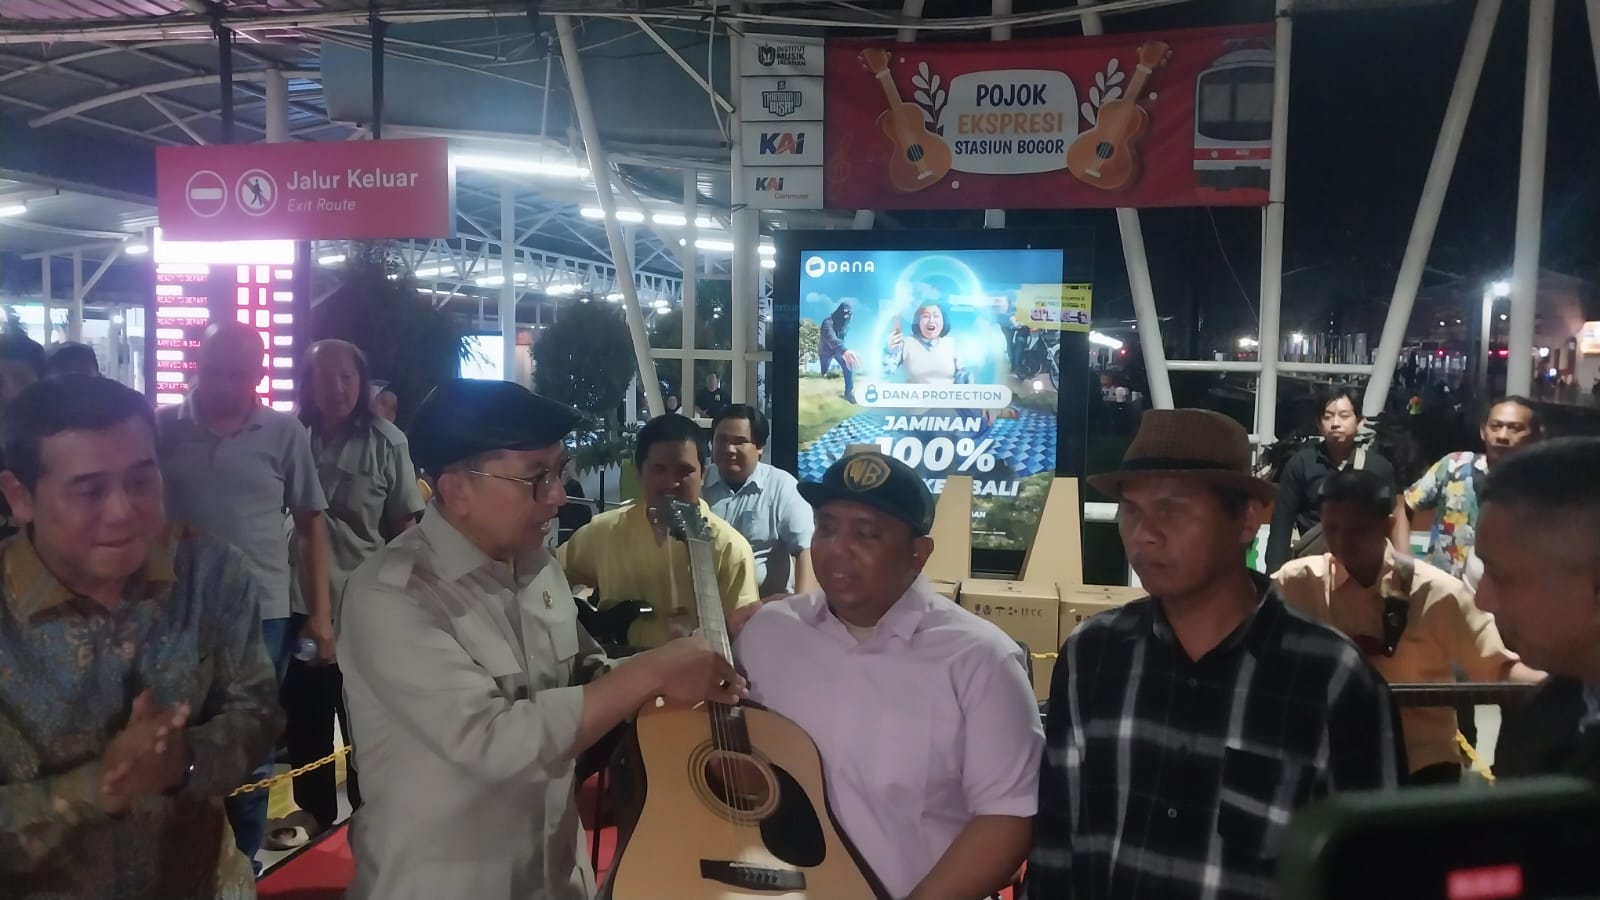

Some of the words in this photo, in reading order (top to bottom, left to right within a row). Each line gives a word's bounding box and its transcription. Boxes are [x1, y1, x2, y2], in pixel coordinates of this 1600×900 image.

[976, 83, 1047, 107] POJOK
[957, 112, 1063, 135] EKSPRESI
[955, 140, 1012, 155] STASIUN
[1017, 139, 1065, 154] BOGOR
[286, 169, 341, 190] Jalur
[347, 168, 419, 188] Keluar
[287, 198, 312, 212] Exit
[317, 198, 356, 211] Route
[828, 260, 875, 273] DANA
[882, 390, 920, 400] DANA
[922, 390, 1002, 401] PROTECTION
[883, 415, 981, 432] JAMINAN
